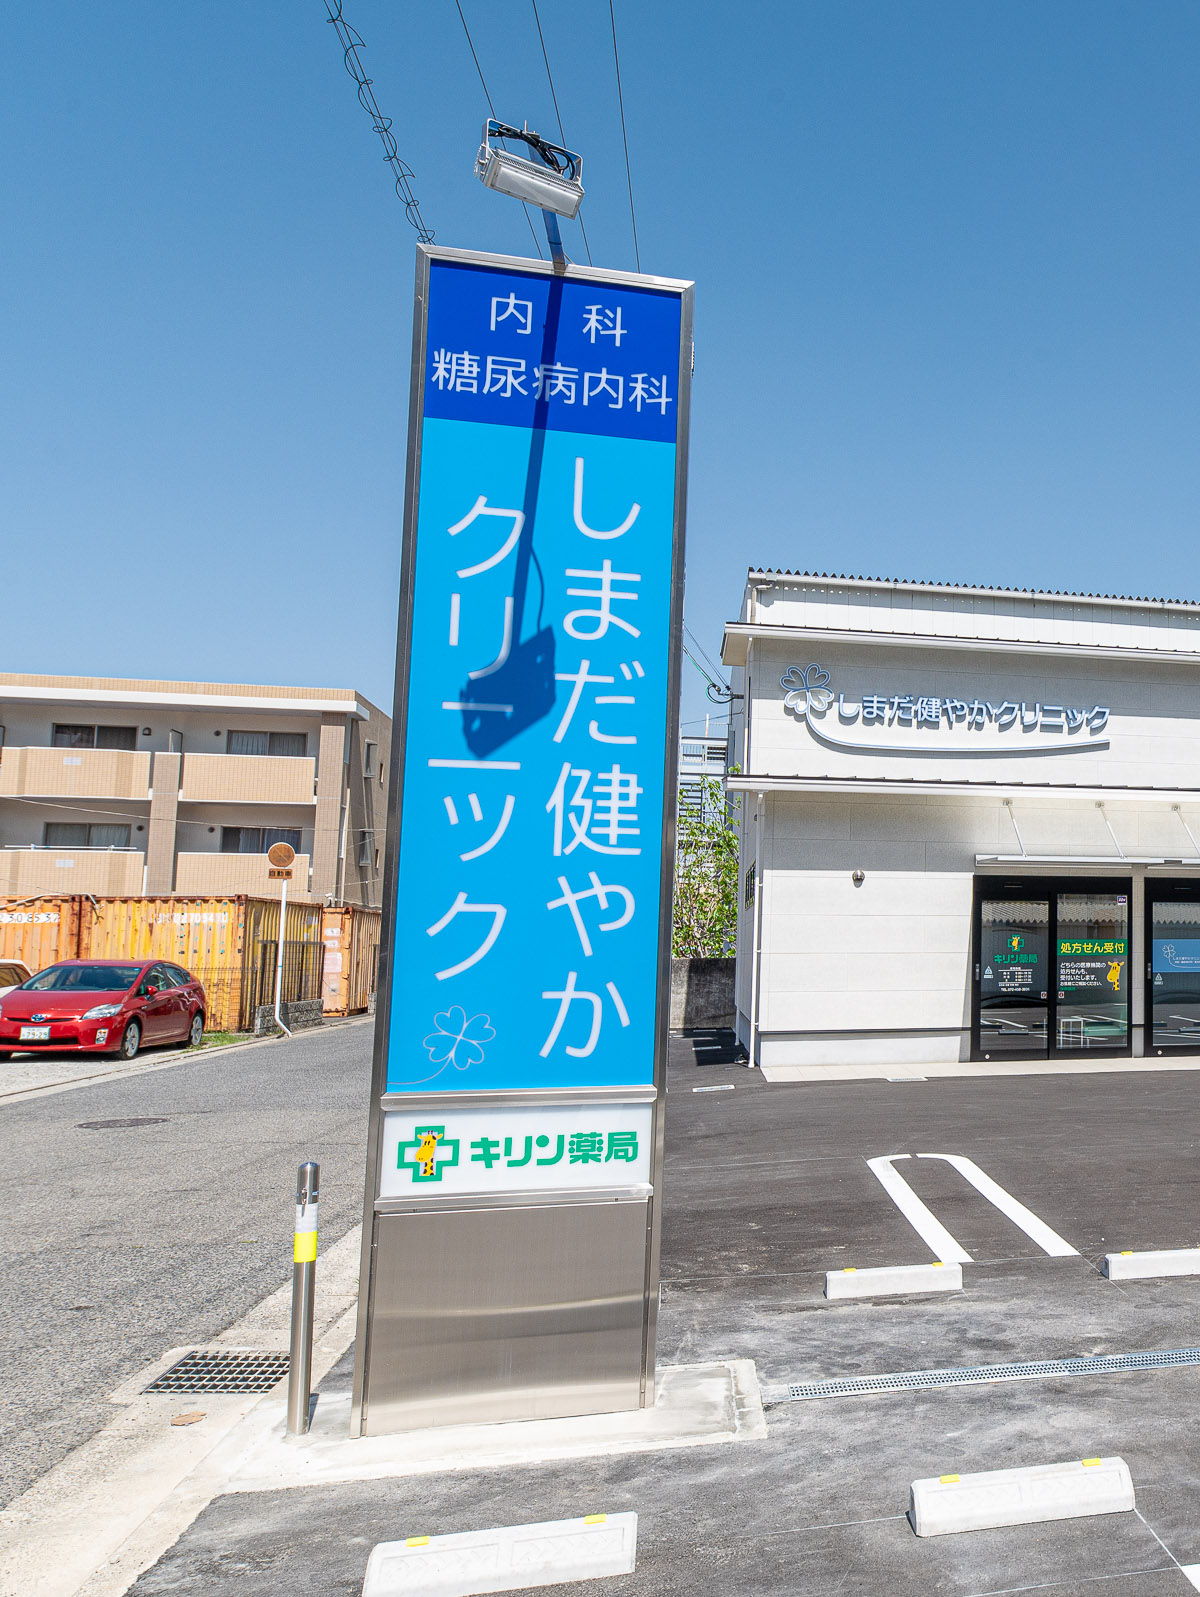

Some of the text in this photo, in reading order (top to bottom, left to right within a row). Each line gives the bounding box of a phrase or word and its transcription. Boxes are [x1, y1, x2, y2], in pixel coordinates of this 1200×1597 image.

[431, 348, 672, 415] 糖尿病内科
[838, 693, 1110, 730] しまだ健やかクリニック
[425, 495, 526, 982] クリニック
[539, 457, 645, 1058] しまだ健やか
[993, 953, 1038, 964] キリン薬局
[1060, 942, 1125, 954] 処方せん受付
[470, 1131, 639, 1169] キリン薬局
